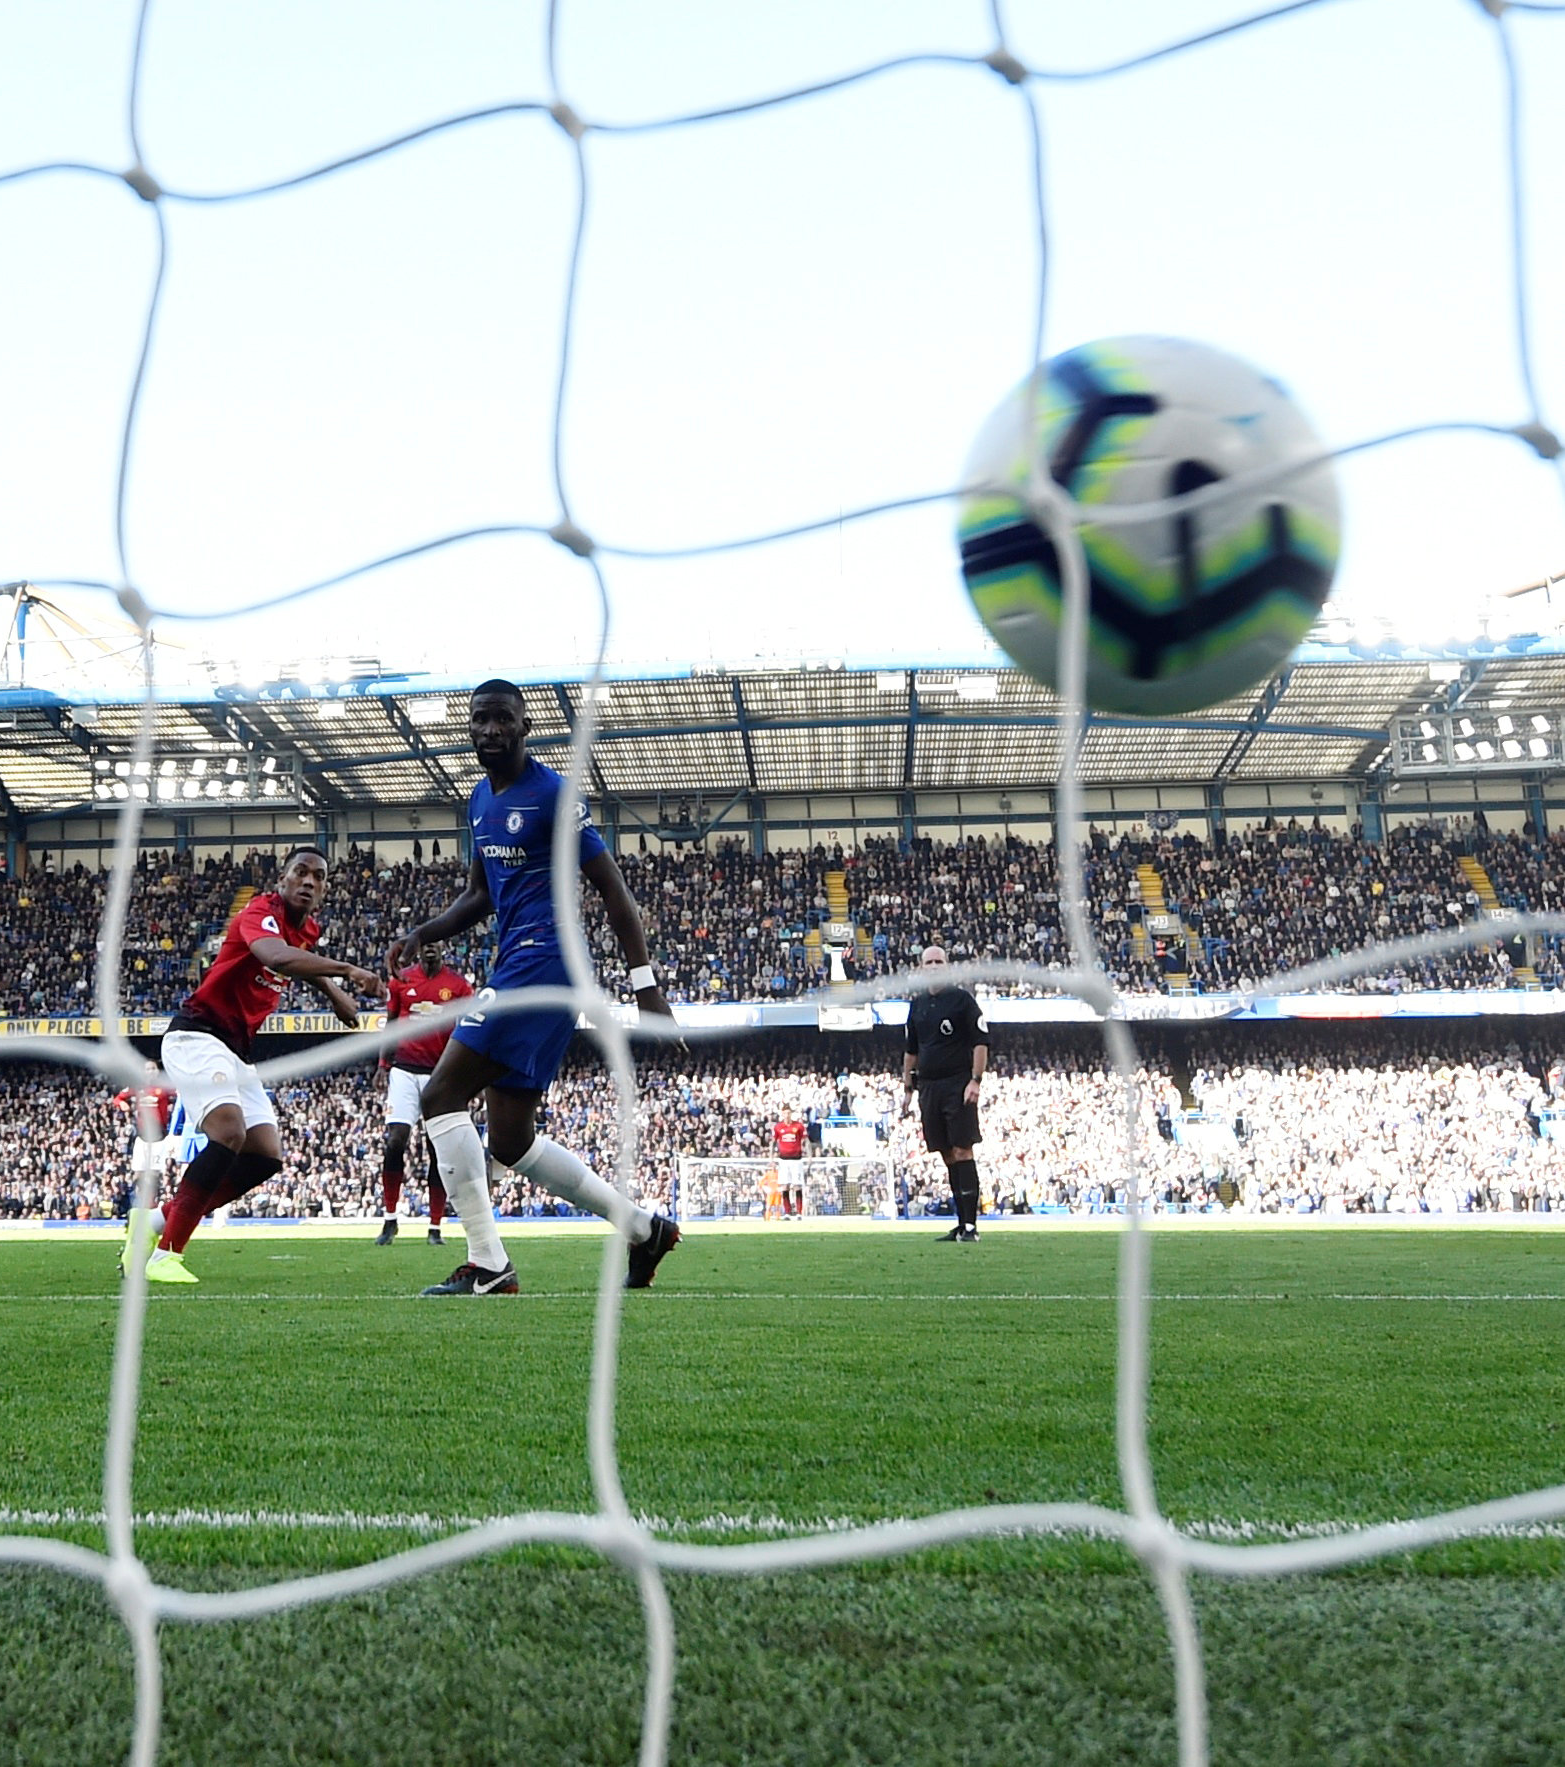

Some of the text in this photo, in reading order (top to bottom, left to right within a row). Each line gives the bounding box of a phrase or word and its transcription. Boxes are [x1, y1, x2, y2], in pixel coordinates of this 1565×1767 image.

[6, 1020, 40, 1036] ONLY
[47, 1019, 92, 1035] PLACE
[126, 1019, 144, 1034] BE
[293, 1015, 370, 1031] SATURAY
